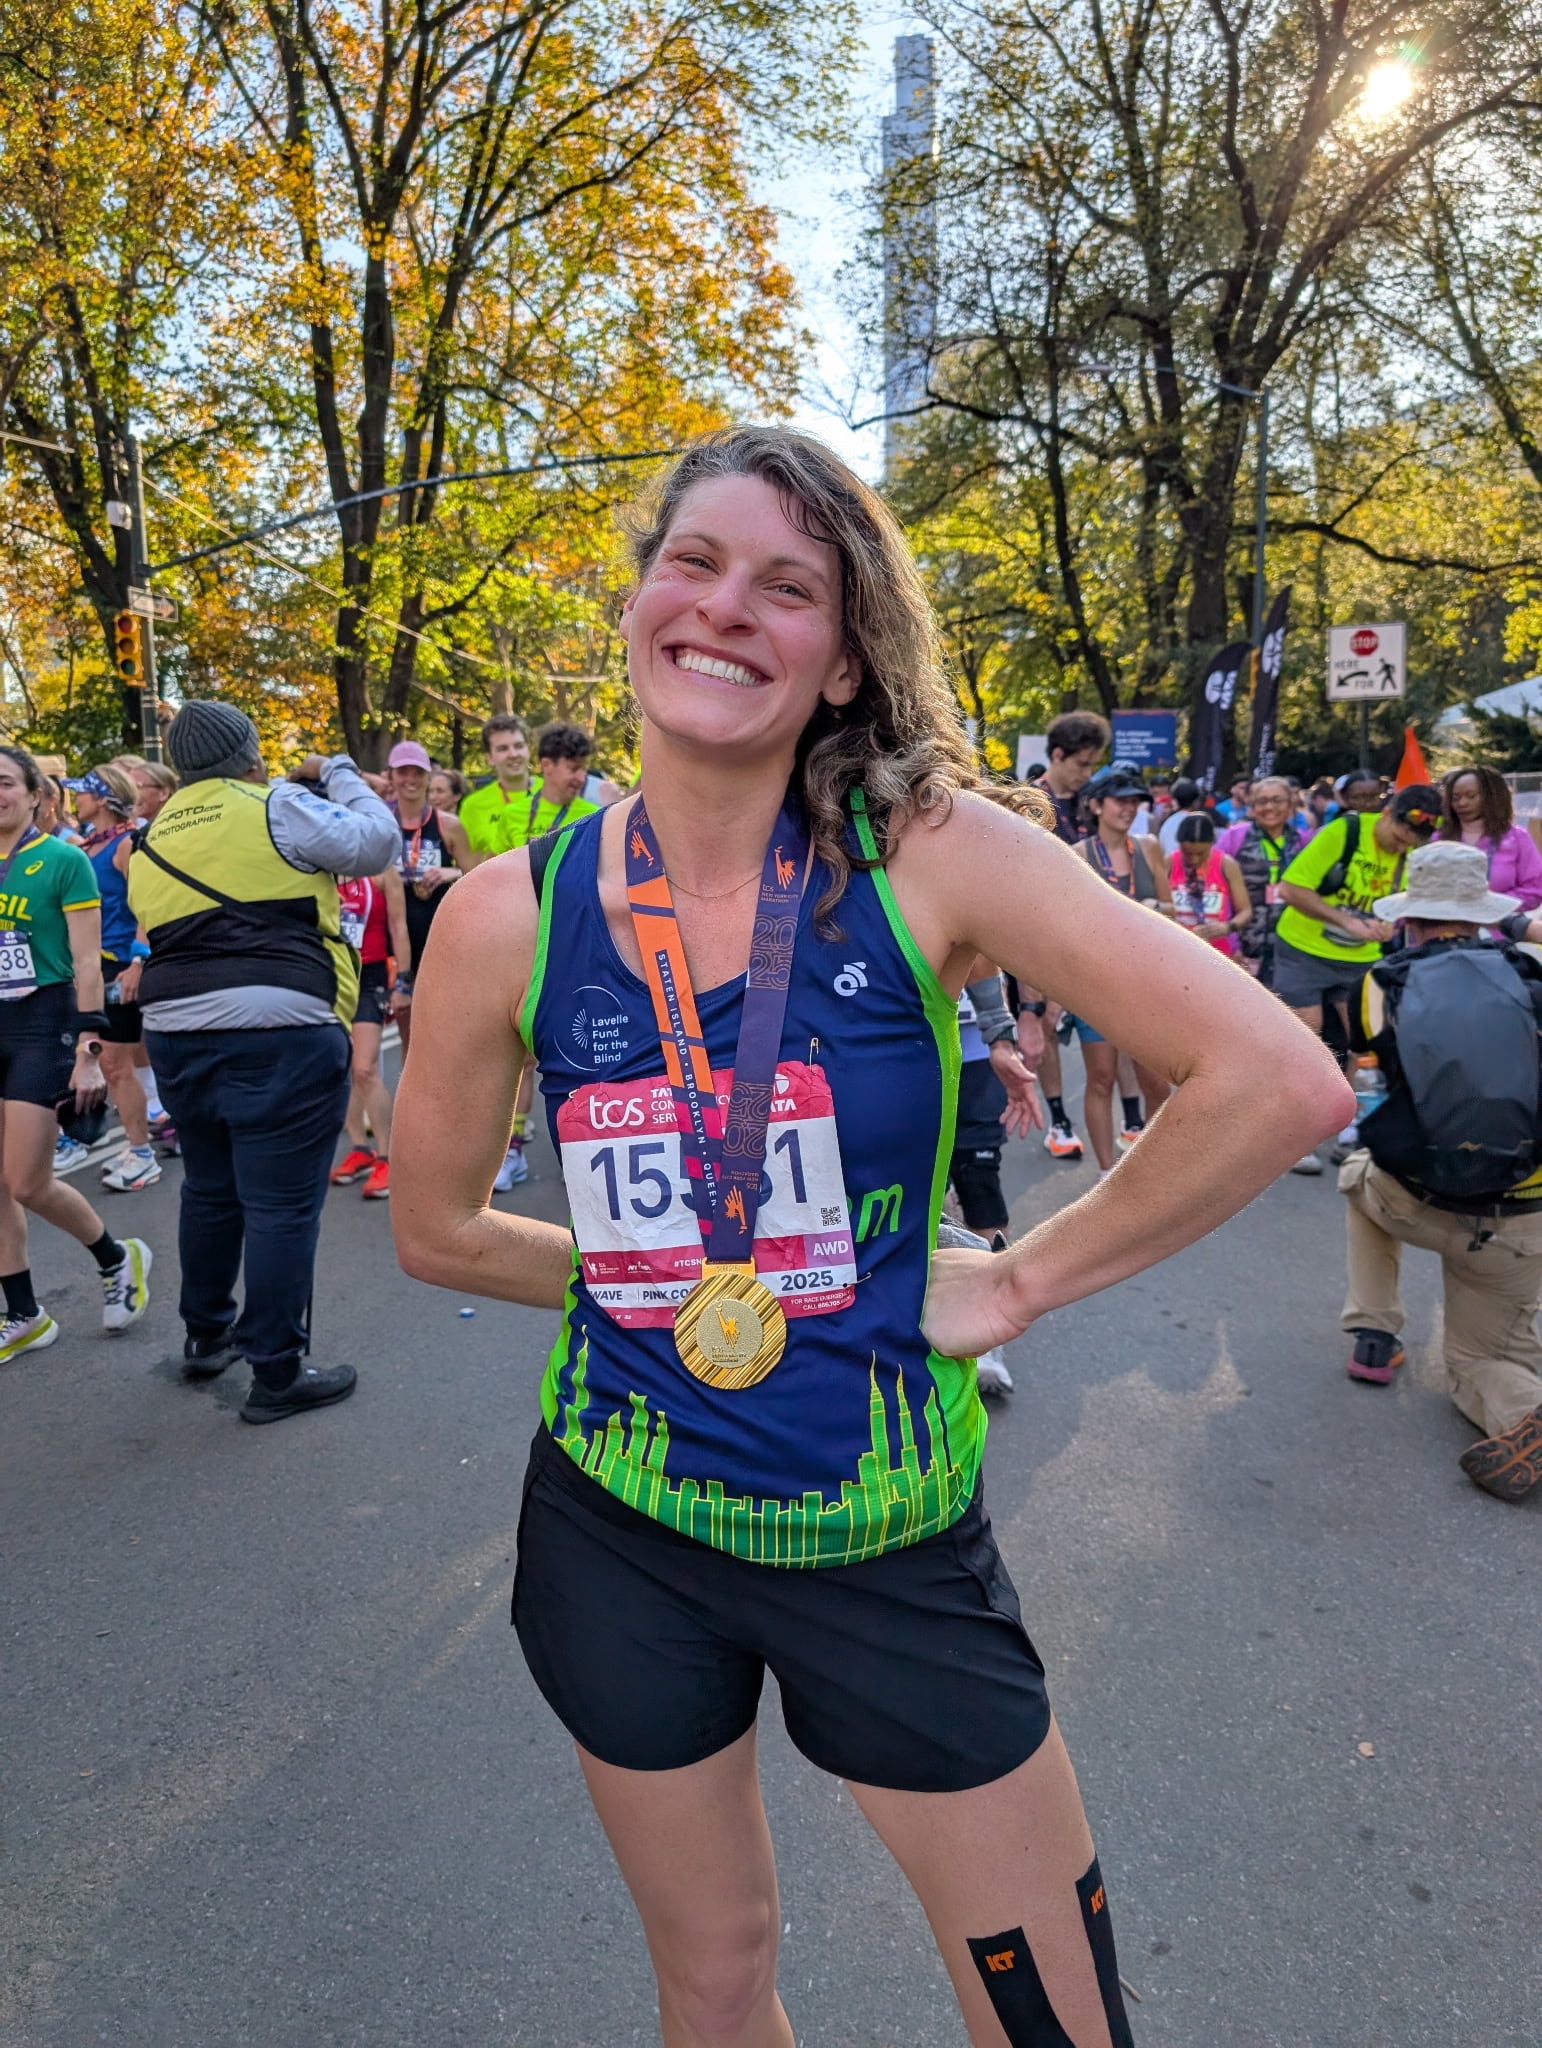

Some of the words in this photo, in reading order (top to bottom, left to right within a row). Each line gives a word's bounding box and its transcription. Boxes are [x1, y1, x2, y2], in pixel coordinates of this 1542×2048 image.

[1350, 636, 1379, 649] STOP
[158, 813, 222, 838] PHOTOGRAPHER
[592, 1014, 629, 1027] Lavelle
[592, 1027, 619, 1039] Fund
[593, 1041, 608, 1051] for
[611, 1040, 629, 1050] the
[594, 1052, 621, 1064] Blind
[658, 953, 675, 1002] STATEN
[670, 1007, 688, 1055] ISLAND
[685, 1073, 706, 1144] BROOKLYN
[703, 1163, 717, 1207] QUEEN
[650, 1087, 673, 1099] TAT
[589, 1095, 645, 1130] tcs
[590, 1129, 807, 1221] 151
[813, 1240, 849, 1257] AWD
[674, 1258, 702, 1268] #TCSN
[780, 1270, 834, 1291] 2025
[592, 1290, 623, 1300] WAVE
[642, 1290, 668, 1300] PINK
[803, 1295, 819, 1303] RACE
[984, 1950, 1016, 1972] KT
